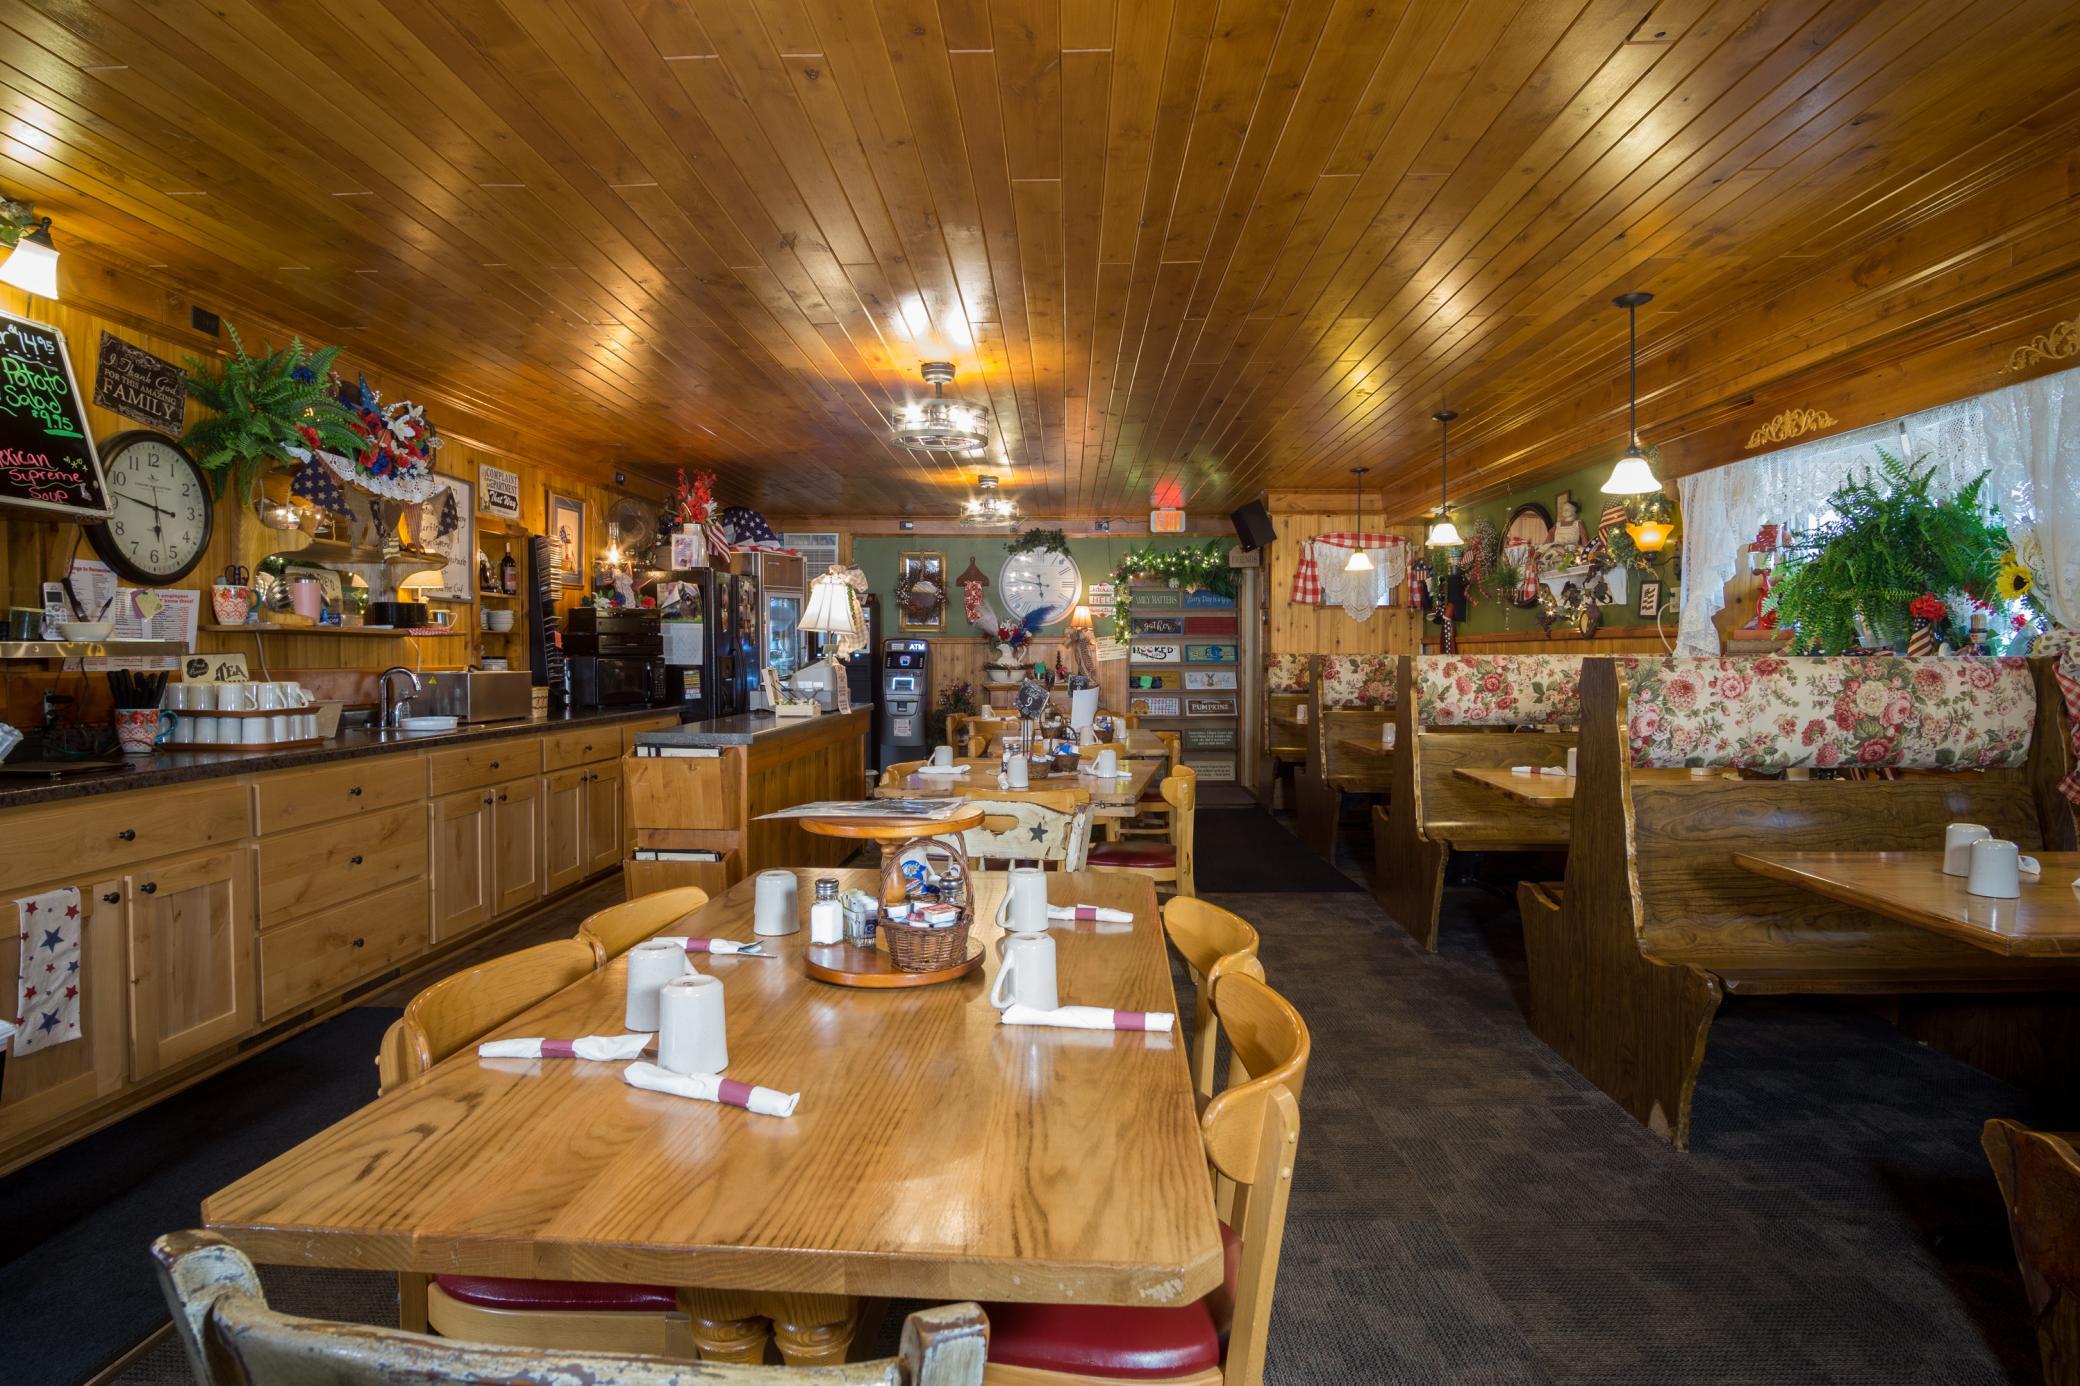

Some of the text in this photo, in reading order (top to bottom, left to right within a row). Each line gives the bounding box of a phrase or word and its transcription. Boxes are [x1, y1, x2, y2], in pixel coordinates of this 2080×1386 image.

[1, 357, 67, 395] Potato
[118, 358, 151, 384] Thank
[155, 376, 178, 394] God
[104, 368, 176, 405] FOR THIS AMAZING
[3, 385, 62, 414] Salad
[103, 377, 175, 420] FAMILY
[0, 447, 51, 470] exican
[129, 455, 139, 471] 11
[148, 453, 160, 468] 12
[9, 469, 84, 486] Supreme
[113, 470, 126, 486] 10
[170, 463, 175, 478] 1
[487, 467, 518, 486] COMPLAINT
[181, 483, 190, 497] 2
[186, 506, 195, 521] 3
[115, 521, 125, 535] 8
[182, 531, 191, 543] 4
[130, 541, 140, 555] 7
[169, 545, 178, 559] 5
[150, 549, 159, 563] 6
[1151, 595, 1177, 605] MATTERS
[1143, 620, 1172, 632] gather
[1132, 646, 1174, 654] HOOKED
[214, 661, 248, 682] TEA
